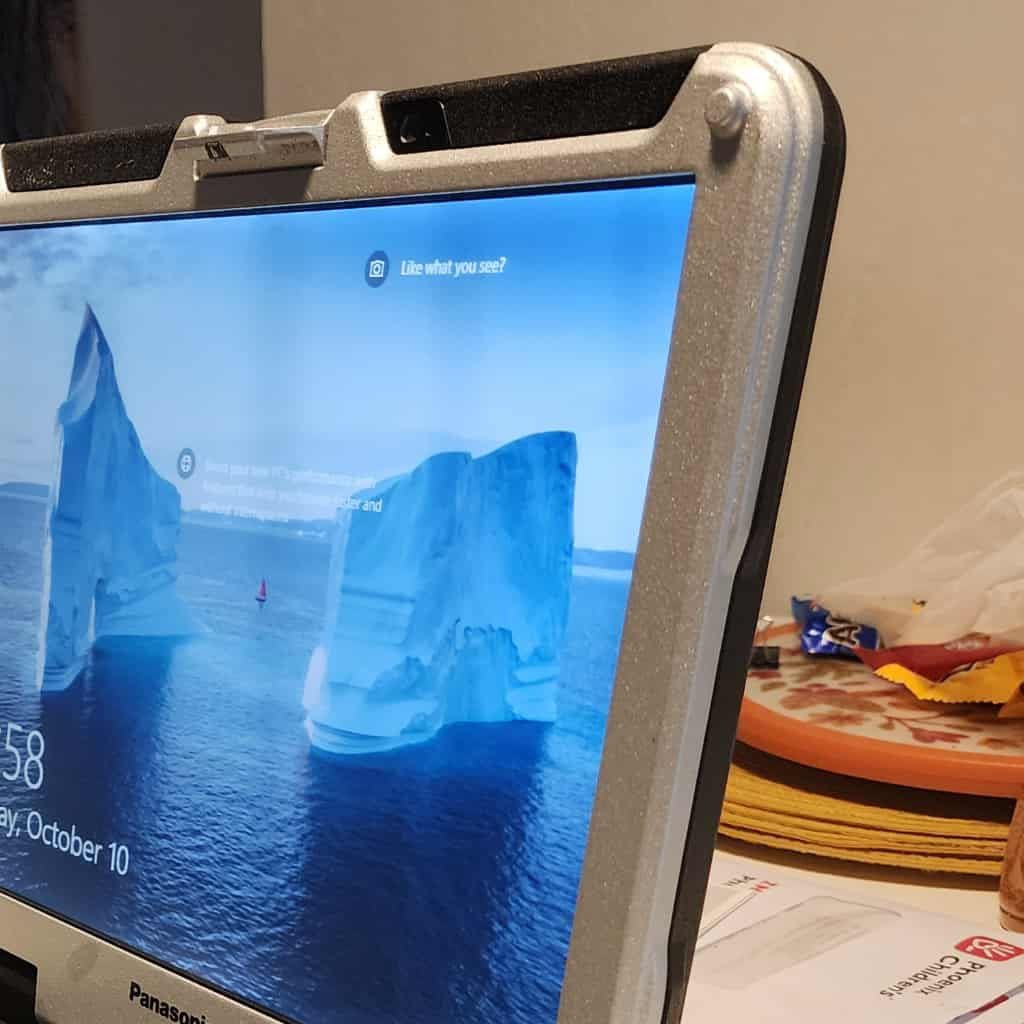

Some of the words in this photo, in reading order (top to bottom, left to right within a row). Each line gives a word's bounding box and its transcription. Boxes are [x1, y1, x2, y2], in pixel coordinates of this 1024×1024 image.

[400, 260, 424, 276] Like
[425, 258, 453, 276] what
[453, 260, 478, 278] you
[479, 256, 507, 274] see?
[361, 497, 384, 513] and
[27, 810, 104, 865] October
[108, 842, 130, 876] 10
[879, 954, 961, 998] Children's
[920, 959, 986, 996] Phoenix
